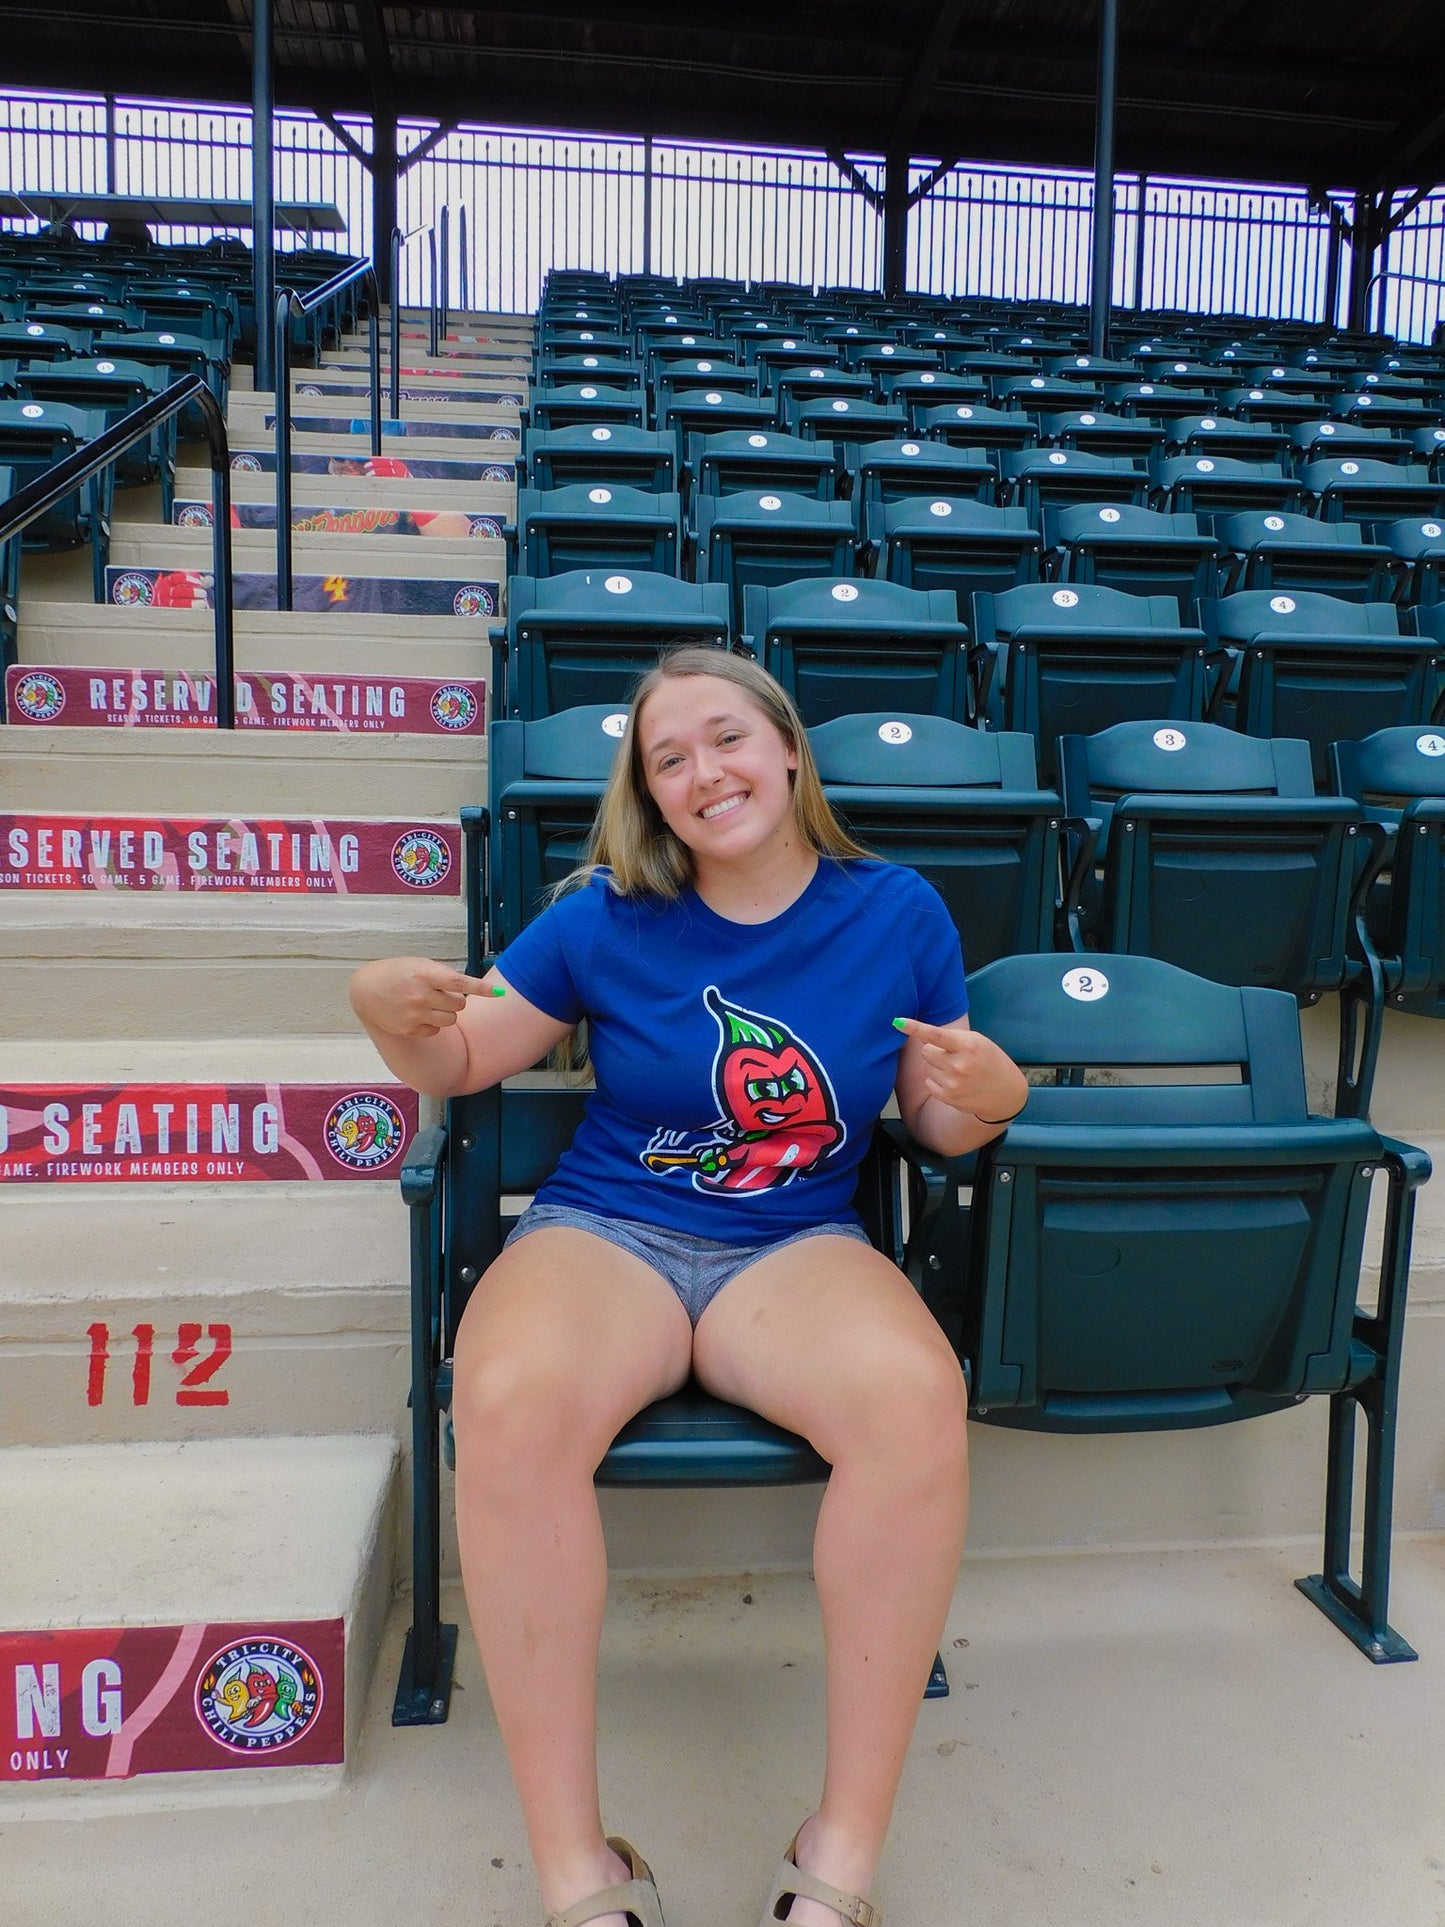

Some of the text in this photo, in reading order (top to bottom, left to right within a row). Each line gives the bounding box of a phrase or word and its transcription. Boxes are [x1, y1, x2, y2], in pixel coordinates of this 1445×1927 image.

[322, 575, 349, 602] 4
[90, 678, 406, 718] RESERVD SEATING
[107, 713, 141, 724] SEASON
[188, 714, 199, 725] 10
[273, 718, 316, 728] FIREWORK
[320, 718, 359, 729] MEMBERS
[363, 719, 385, 729] ONLY
[890, 728, 901, 739] 2
[1165, 734, 1175, 746] 3
[1427, 740, 1438, 751] 4
[188, 831, 360, 873] SEATING
[81, 873, 94, 884] 10
[139, 874, 146, 885] 5
[190, 875, 246, 887] FIREWORK
[250, 875, 301, 887] MEMBERS
[306, 876, 335, 888] ONLY
[1079, 976, 1094, 993] 2
[336, 1096, 393, 1113] TRI-CITY
[43, 1102, 280, 1156] SEATING
[328, 1130, 401, 1167] CHILI PEPPERS
[0, 1160, 245, 1178] AME. FIREWORK MEMBERS ONLY
[86, 1322, 232, 1406] 112
[216, 1642, 303, 1669] TRI-CITY
[201, 1692, 316, 1749] CHILI PEPPERS
[9, 1749, 70, 1771] ONLY
